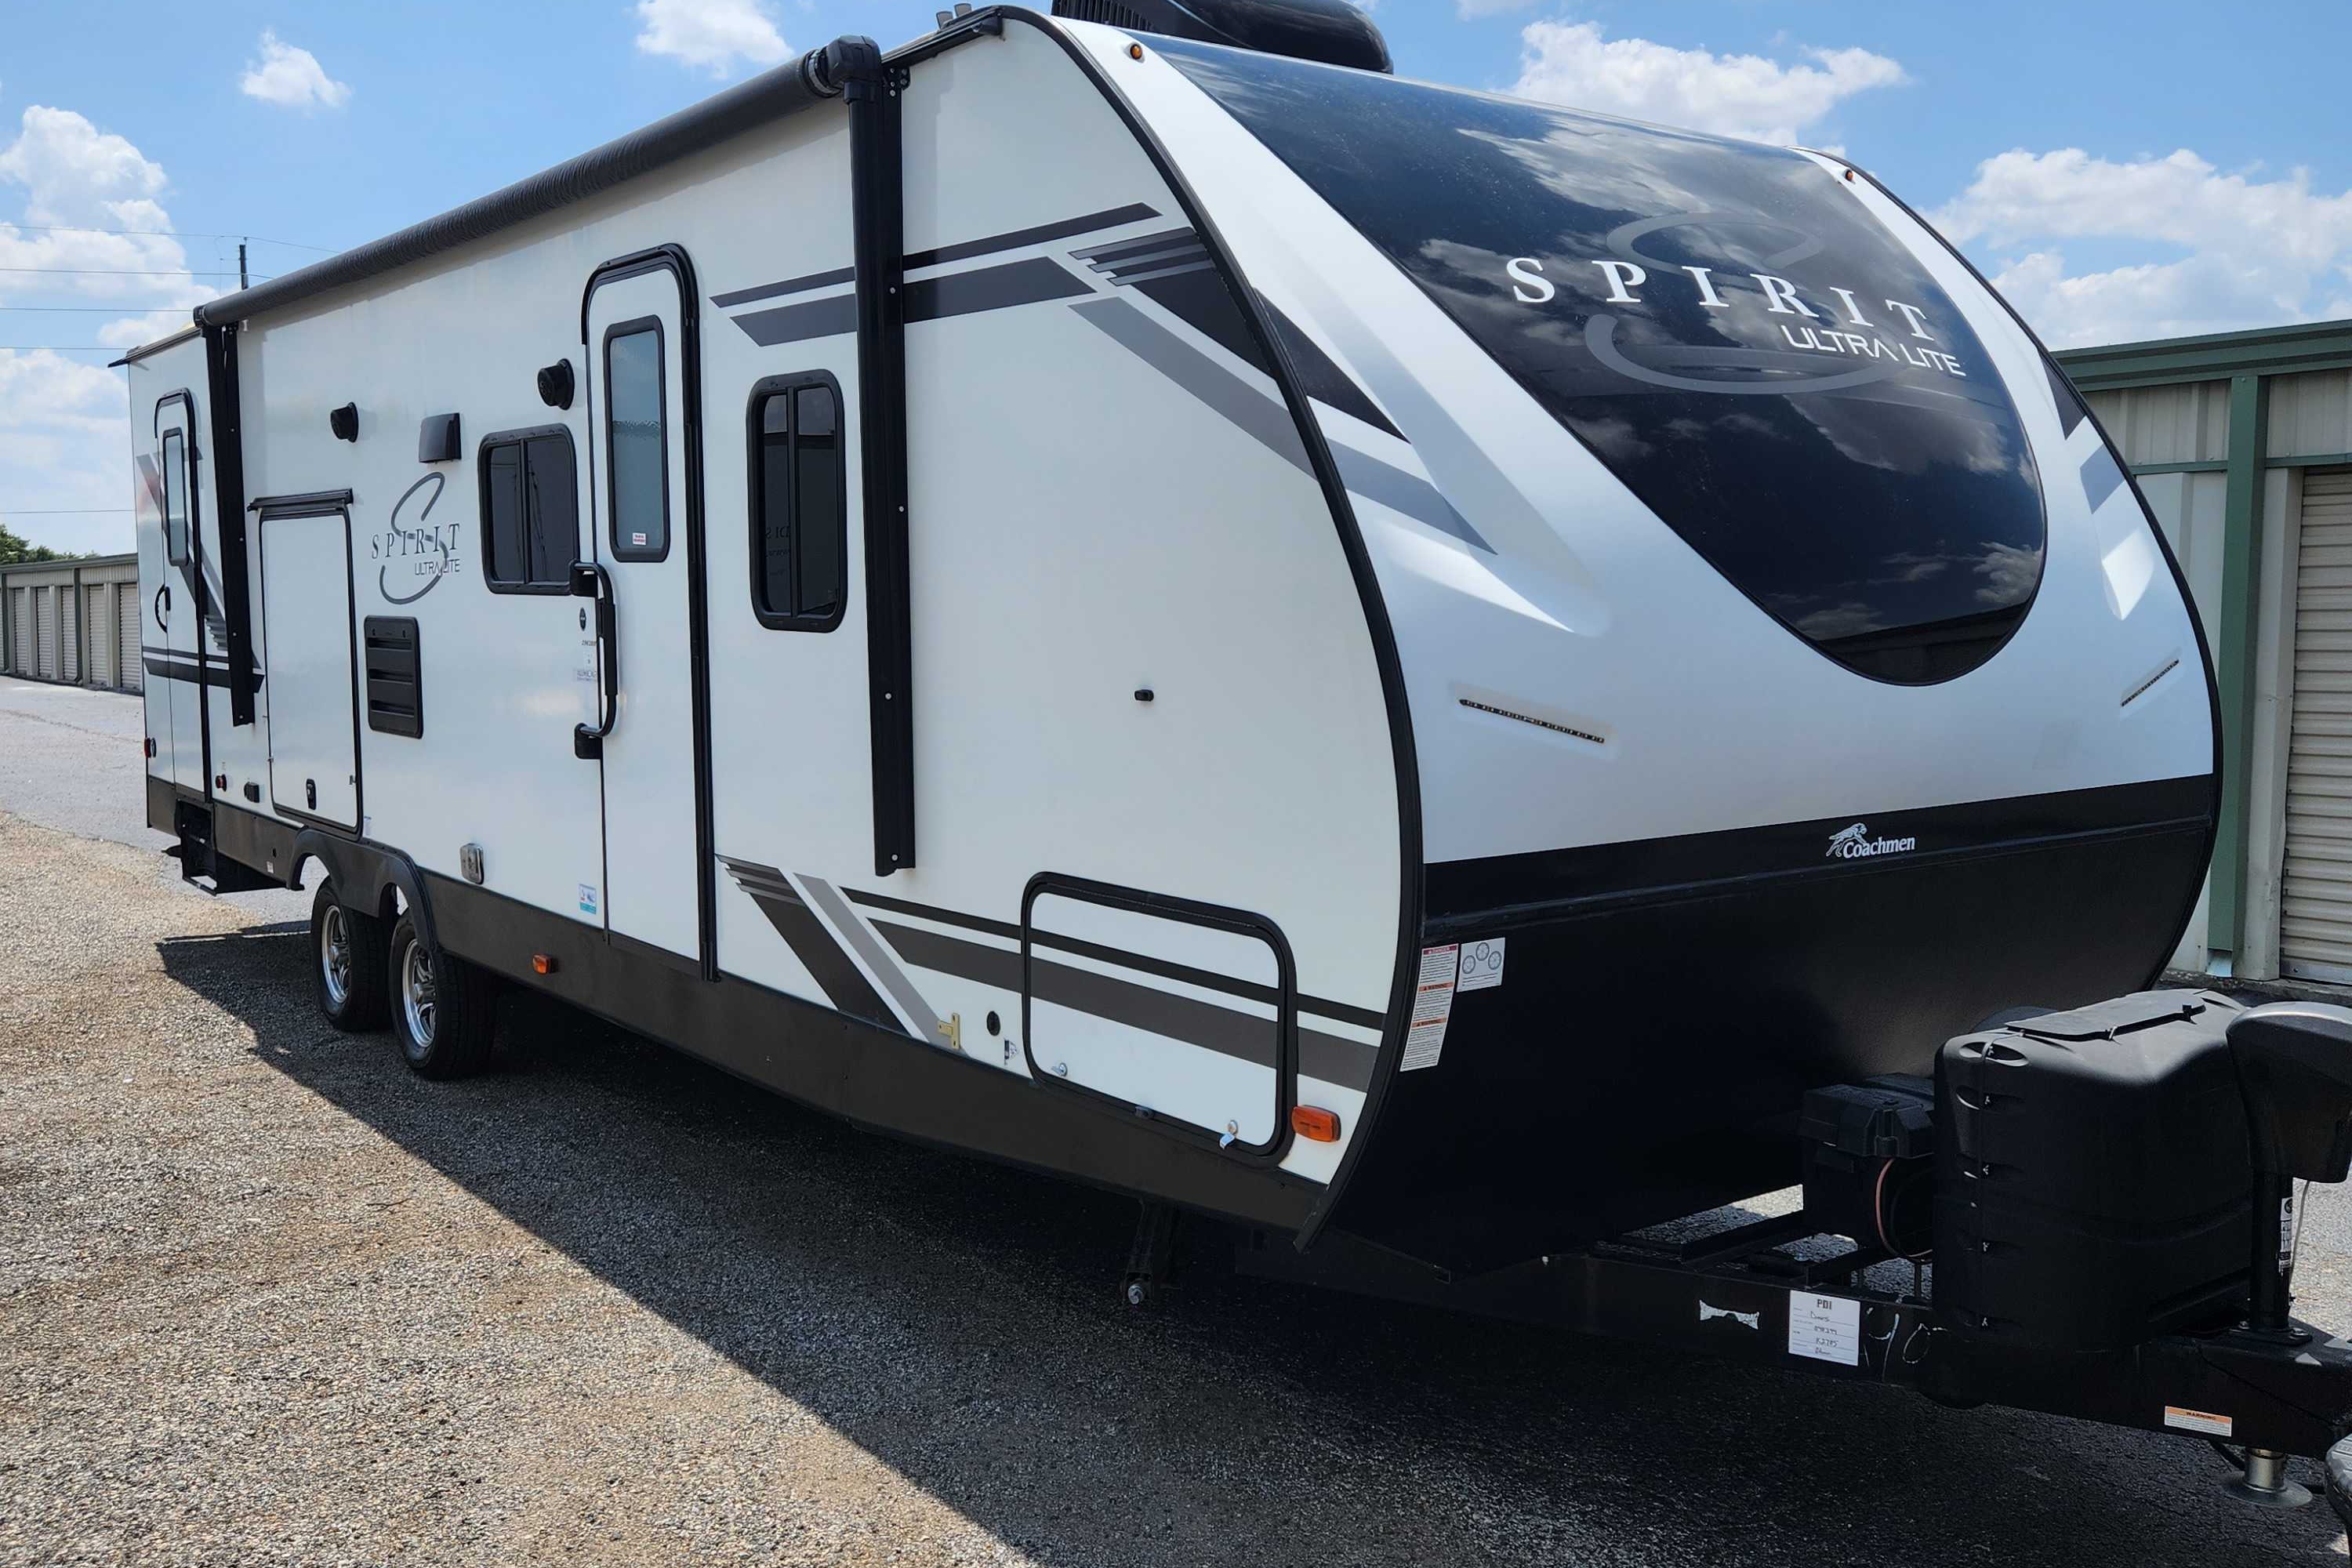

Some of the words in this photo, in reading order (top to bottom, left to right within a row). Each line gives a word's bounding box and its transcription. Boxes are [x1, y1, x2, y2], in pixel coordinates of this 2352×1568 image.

[1505, 256, 1935, 341] SPIRIT
[1780, 325, 1900, 362] ULTRA
[1900, 343, 1967, 376] LITE
[371, 522, 460, 560] SPIRIT
[1842, 836, 1916, 858] Coachmen
[1817, 1298, 1832, 1310] PDI
